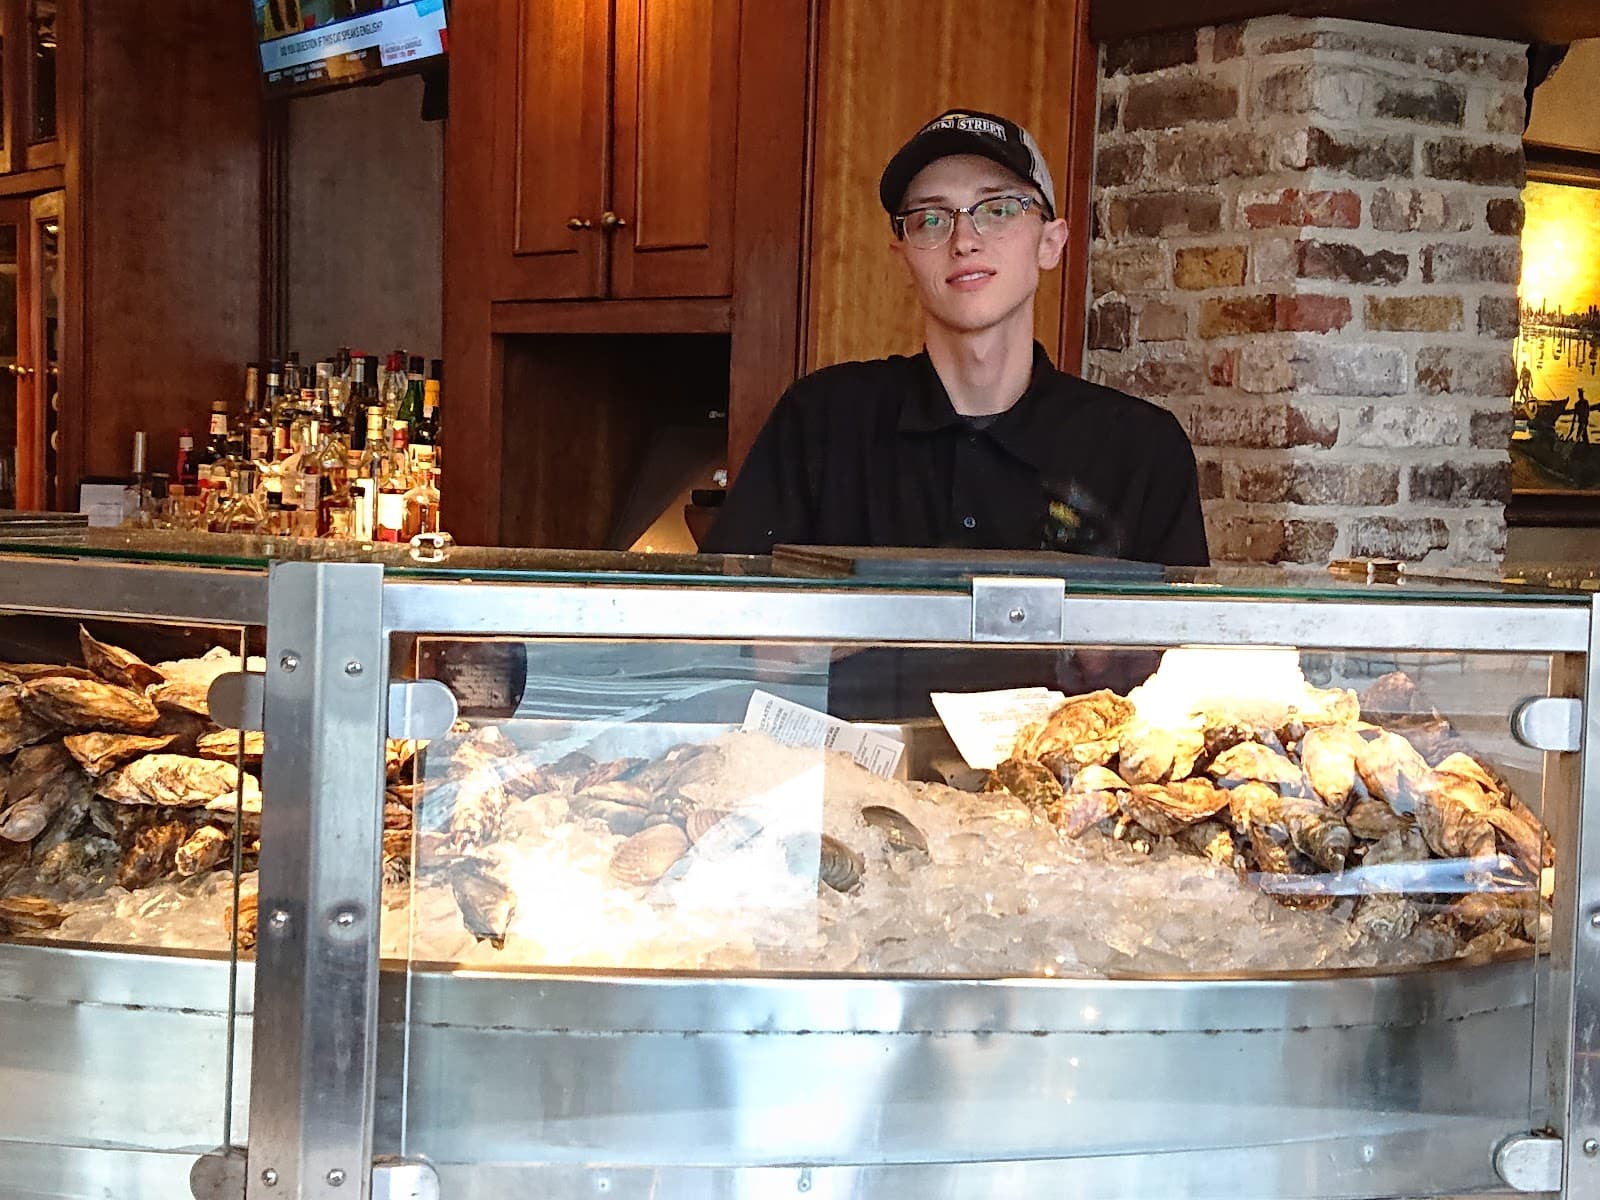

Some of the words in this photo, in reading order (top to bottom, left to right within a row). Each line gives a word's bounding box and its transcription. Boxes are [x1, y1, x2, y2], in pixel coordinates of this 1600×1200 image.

[295, 38, 317, 53] QUESTION
[341, 26, 360, 41] SPEAKS
[959, 119, 1004, 139] STREET
